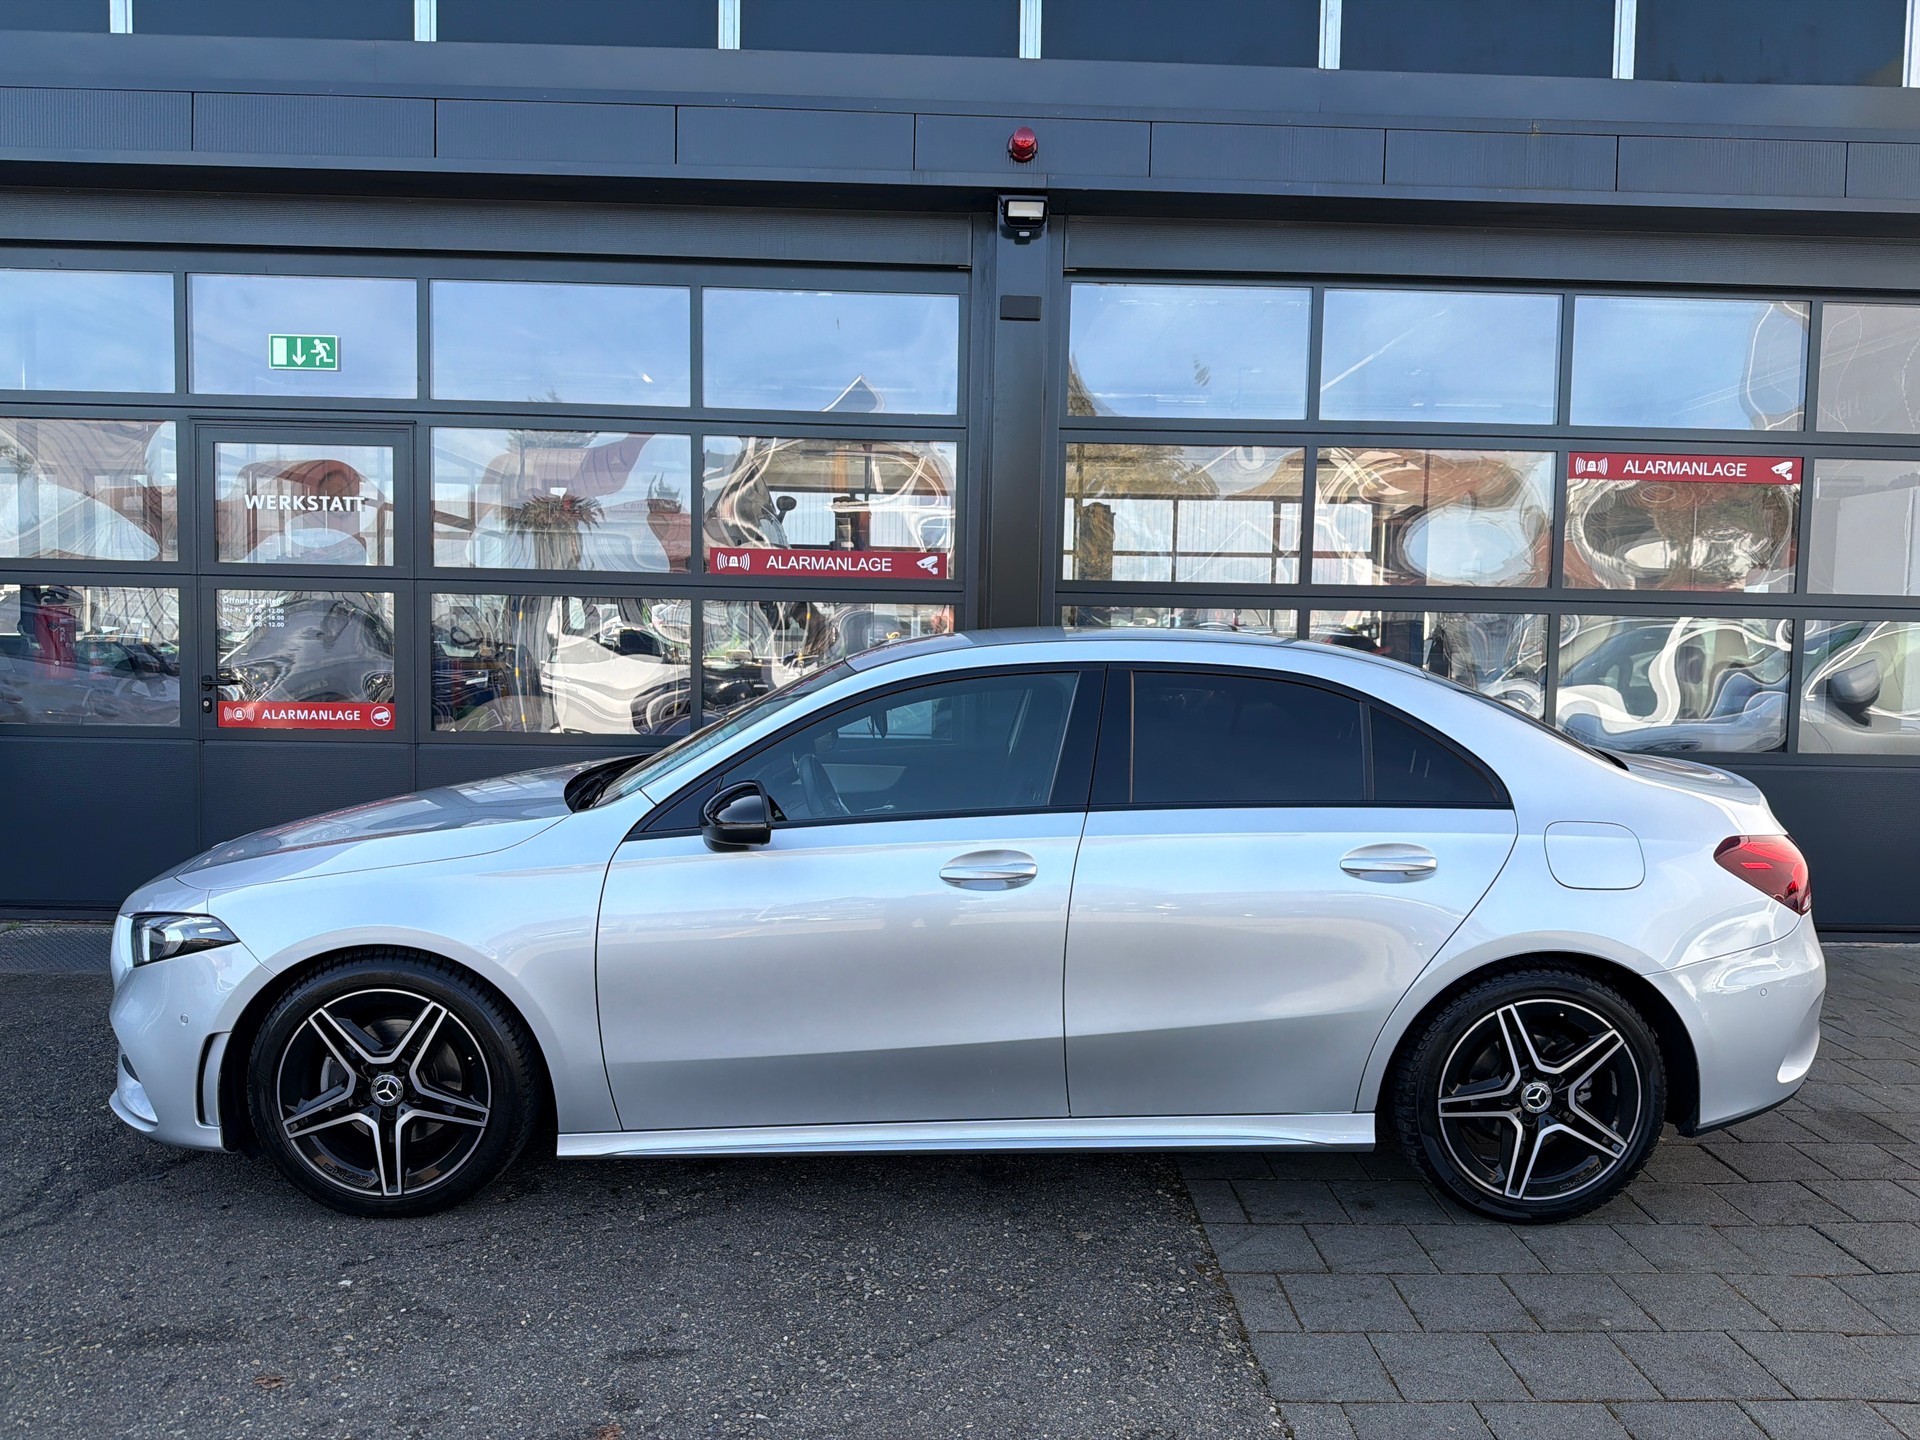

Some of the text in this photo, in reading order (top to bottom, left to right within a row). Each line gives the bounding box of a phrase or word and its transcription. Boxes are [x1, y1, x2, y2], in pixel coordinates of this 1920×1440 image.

[1623, 460, 1747, 477] ALARMANLAGE
[244, 494, 365, 511] WERKSTATT
[766, 555, 892, 572] ALARMANLAGE
[261, 709, 361, 721] ALARMANLAGE
